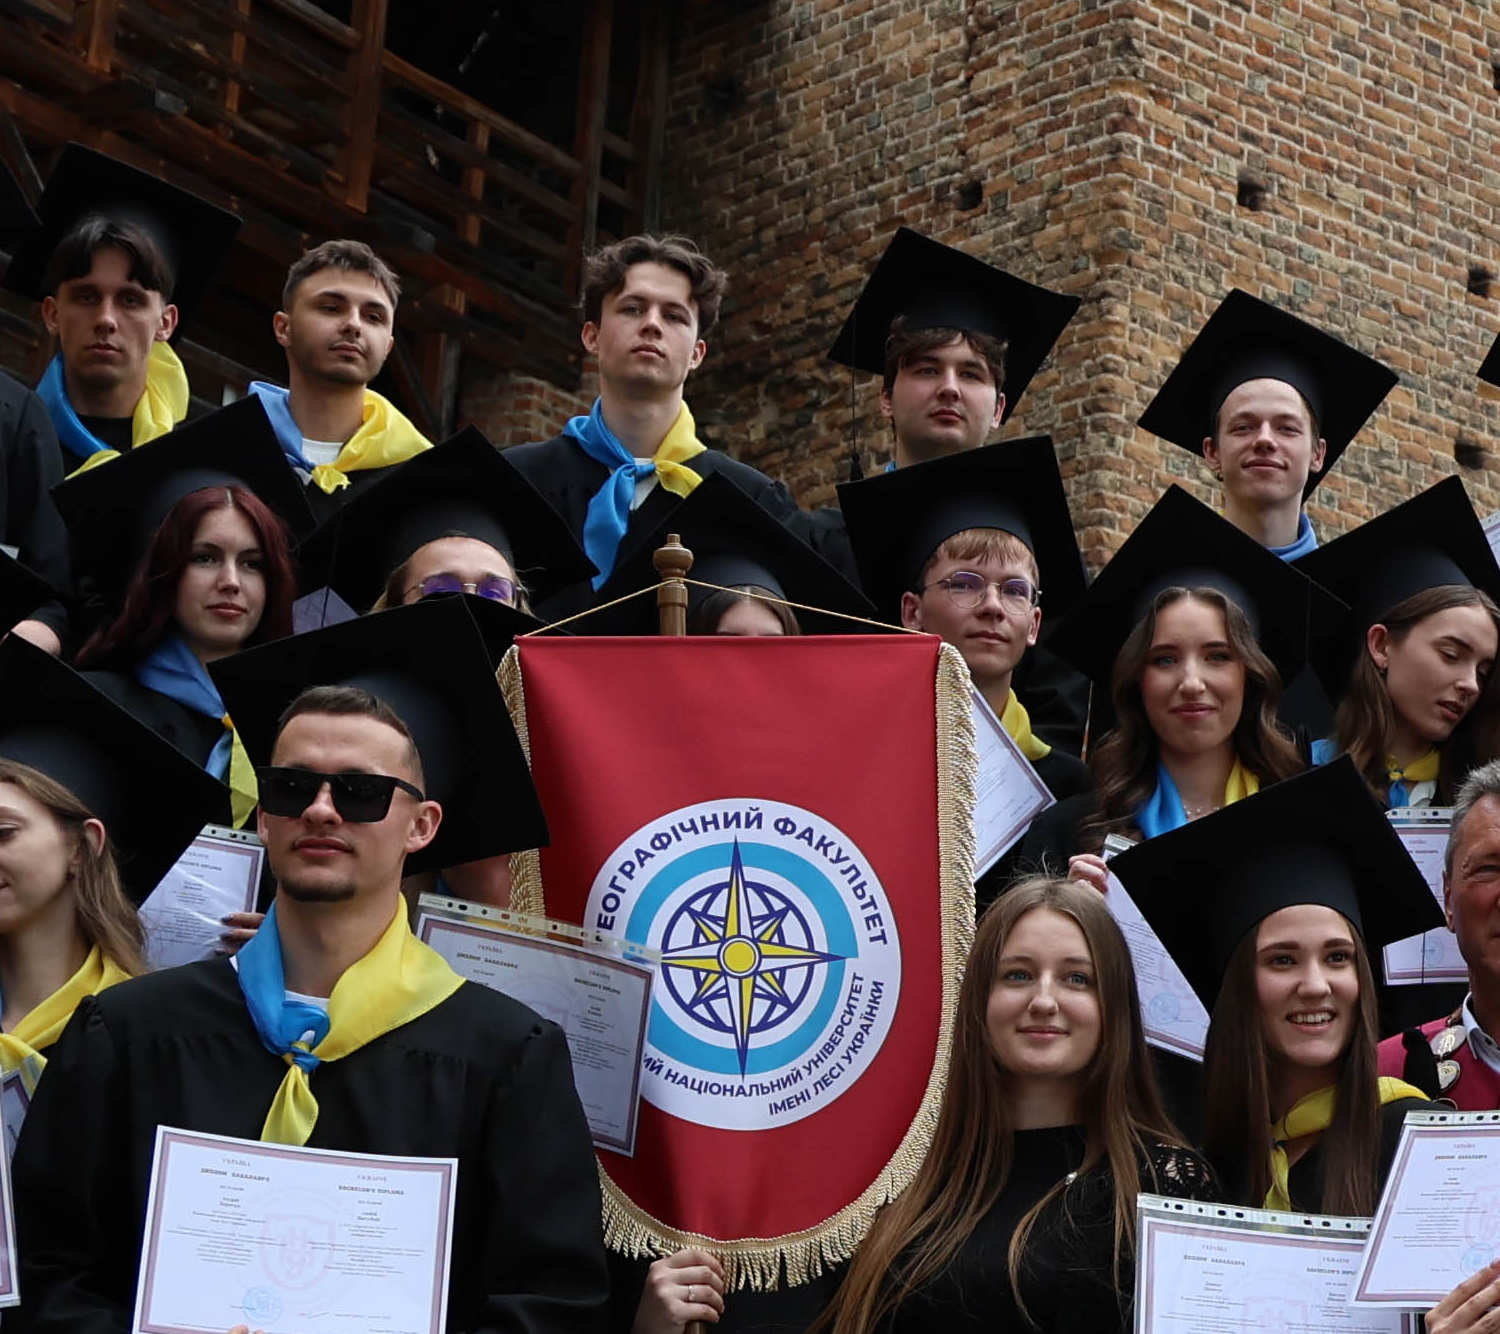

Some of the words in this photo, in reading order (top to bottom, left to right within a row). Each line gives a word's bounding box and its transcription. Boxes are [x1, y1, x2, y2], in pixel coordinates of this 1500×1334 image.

[773, 817, 888, 945] ФАКУЛЬТЕТ
[664, 1067, 803, 1097] НАЦІОНАЛЬНИЙ
[803, 972, 865, 1076] УНІВЕРСИТЕТ
[768, 1089, 812, 1116] ІМЕНІ
[814, 1062, 846, 1095] ЛЕСІ
[841, 980, 885, 1064] УКРАЇНКИ
